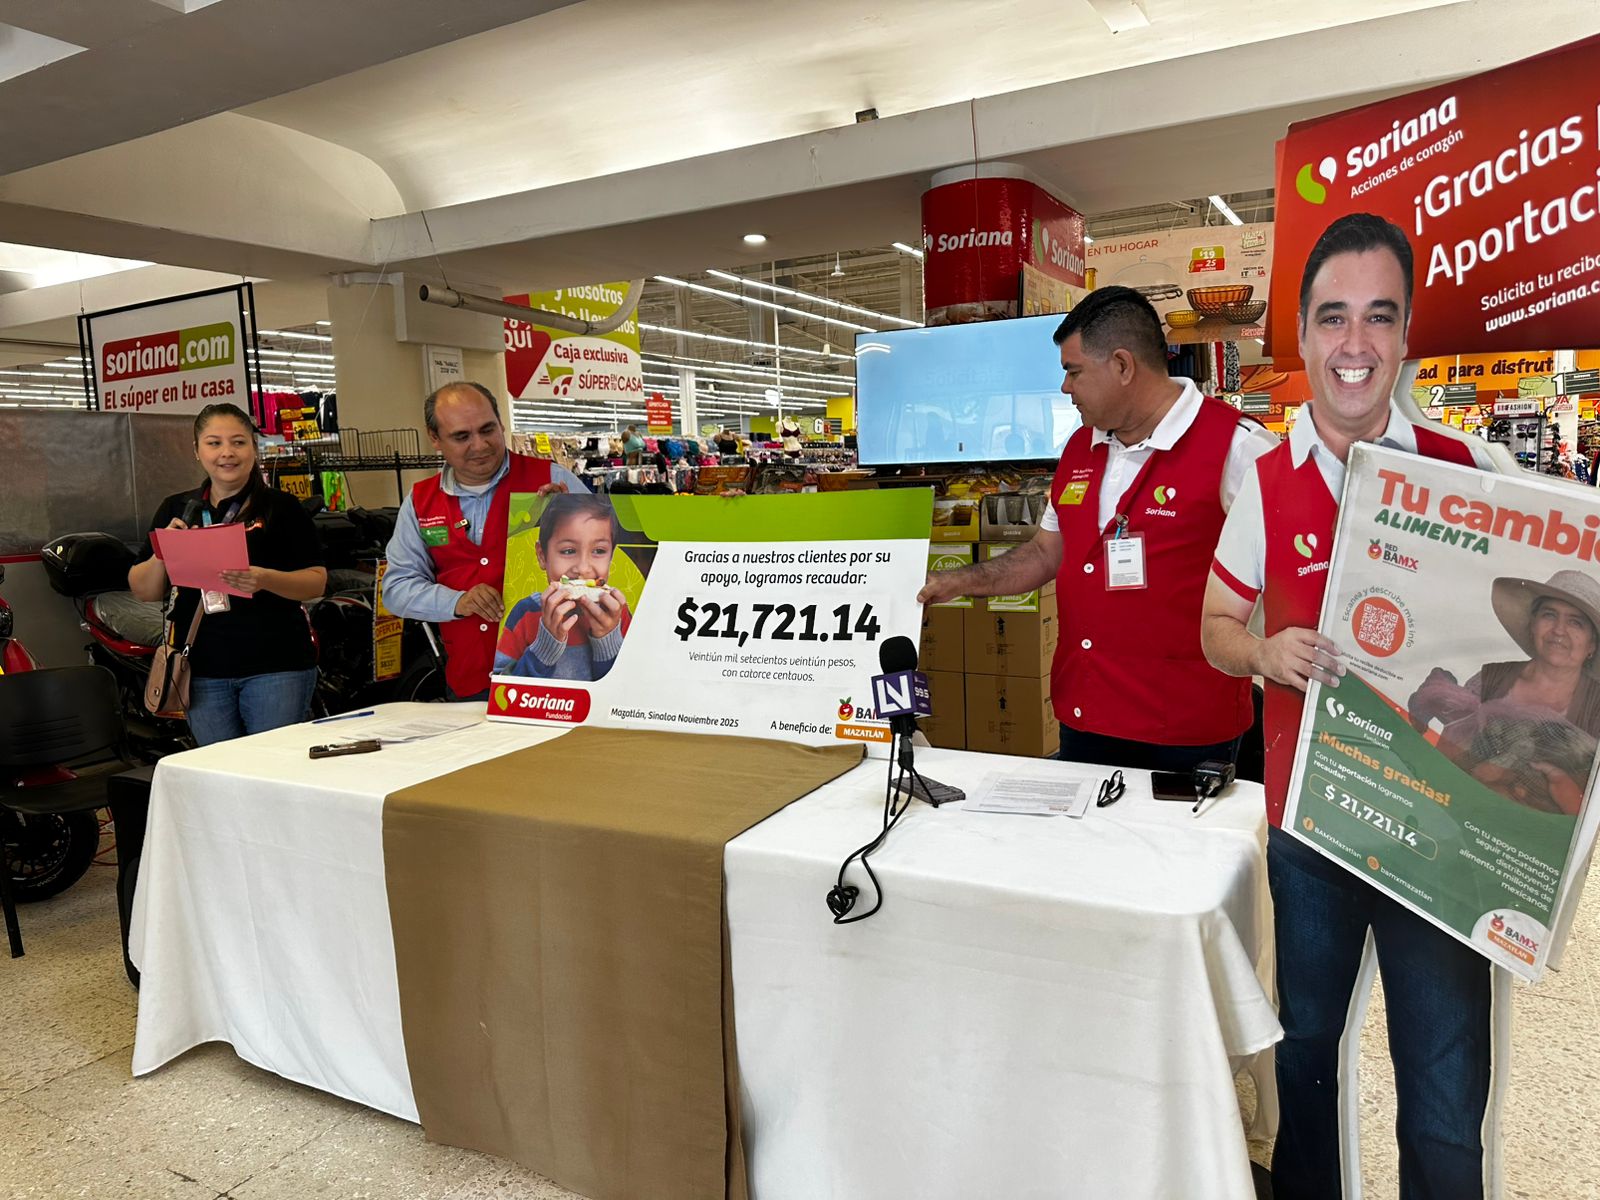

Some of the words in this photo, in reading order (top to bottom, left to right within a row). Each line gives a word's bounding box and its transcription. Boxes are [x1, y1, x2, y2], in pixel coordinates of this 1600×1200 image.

[1346, 96, 1457, 178] Soriana
[1350, 165, 1398, 199] Acciones
[1399, 155, 1414, 172] de
[1416, 128, 1464, 162] corazón
[1414, 115, 1583, 237] ¡Gracias
[937, 227, 1013, 253] Soriana
[1087, 247, 1101, 257] EN
[1103, 245, 1117, 254] TU
[1120, 239, 1159, 252] HOGAR
[1051, 239, 1084, 277] Soriana
[1481, 281, 1534, 311] Solicita
[1538, 273, 1553, 289] tu
[106, 335, 230, 376] soriana.com
[553, 344, 581, 363] Caja
[583, 347, 629, 364] exclusiva
[579, 369, 610, 390] SÚPER
[617, 376, 643, 392] CASA
[1415, 364, 1438, 380] ad
[1448, 365, 1484, 382] para
[1551, 373, 1565, 396] 1
[105, 390, 117, 410] El
[120, 385, 159, 411] súper
[162, 385, 178, 403] en
[182, 380, 197, 400] tu
[201, 379, 235, 398] casa
[1230, 394, 1242, 410] 3
[1430, 385, 1446, 407] 2
[814, 418, 823, 433] 6
[1145, 507, 1177, 517] Soriana
[1377, 469, 1430, 516] Tu
[1439, 495, 1600, 563] cambi
[1374, 508, 1490, 555] ALIMENTA
[684, 550, 729, 564] Gracias
[732, 553, 740, 563] a
[742, 552, 795, 564] nuestros
[797, 550, 847, 564] clientes
[849, 552, 872, 566] por
[875, 552, 891, 563] su
[1384, 543, 1398, 553] RED
[1297, 561, 1329, 577] Soriana
[1383, 551, 1419, 571] BAMX
[700, 573, 741, 588] apoyo,
[744, 571, 803, 588] logramos
[806, 571, 867, 584] recaudar:
[1362, 588, 1368, 597] y
[1342, 591, 1362, 622] Escanea
[1404, 607, 1415, 628] más
[674, 597, 881, 648] $21,721.14
[1406, 630, 1416, 648] info
[689, 651, 723, 663] Veintiún
[724, 652, 738, 663] mil
[740, 654, 788, 666] setecientos
[789, 655, 826, 667] veintiún
[828, 658, 856, 669] pesos,
[721, 668, 738, 678] con
[739, 669, 771, 680] catorce
[773, 670, 815, 682] centavos.
[519, 693, 575, 712] Soriana
[546, 711, 572, 721] Fundación
[611, 708, 646, 720] Mazatlán,
[648, 711, 676, 722] Sinaloa
[678, 714, 718, 726] Noviembre
[720, 717, 739, 728] 2025
[770, 720, 777, 730] A
[779, 721, 817, 735] beneficio
[819, 725, 832, 735] de:
[1346, 711, 1394, 742] Soriana
[843, 727, 885, 739] MAZATLÁN
[1313, 759, 1347, 782] recaudar:
[1315, 750, 1329, 763] Con
[1329, 757, 1337, 767] tu
[1337, 763, 1377, 789] aportación
[1377, 783, 1414, 808] logramos
[1318, 730, 1380, 770] ¡Muchas
[1383, 765, 1451, 807] gracias!
[1324, 784, 1336, 801] $
[1340, 792, 1417, 847] 21,721.14
[1314, 827, 1362, 860] BAMXMazatlan
[1464, 820, 1480, 835] Con
[1481, 830, 1491, 840] tu
[1491, 836, 1517, 854] apoyo
[1517, 850, 1560, 877] podemos
[1475, 837, 1501, 855] seguir
[1502, 851, 1550, 881] rescatando
[1551, 878, 1557, 886] y
[1380, 866, 1433, 902] bamxmazatlan
[1459, 848, 1495, 872] alimento
[1502, 871, 1539, 896] millones
[1540, 891, 1552, 903] de
[1495, 858, 1555, 894] distribuyendo
[1501, 881, 1549, 912] mexicanos.
[1504, 926, 1540, 952] BAMX
